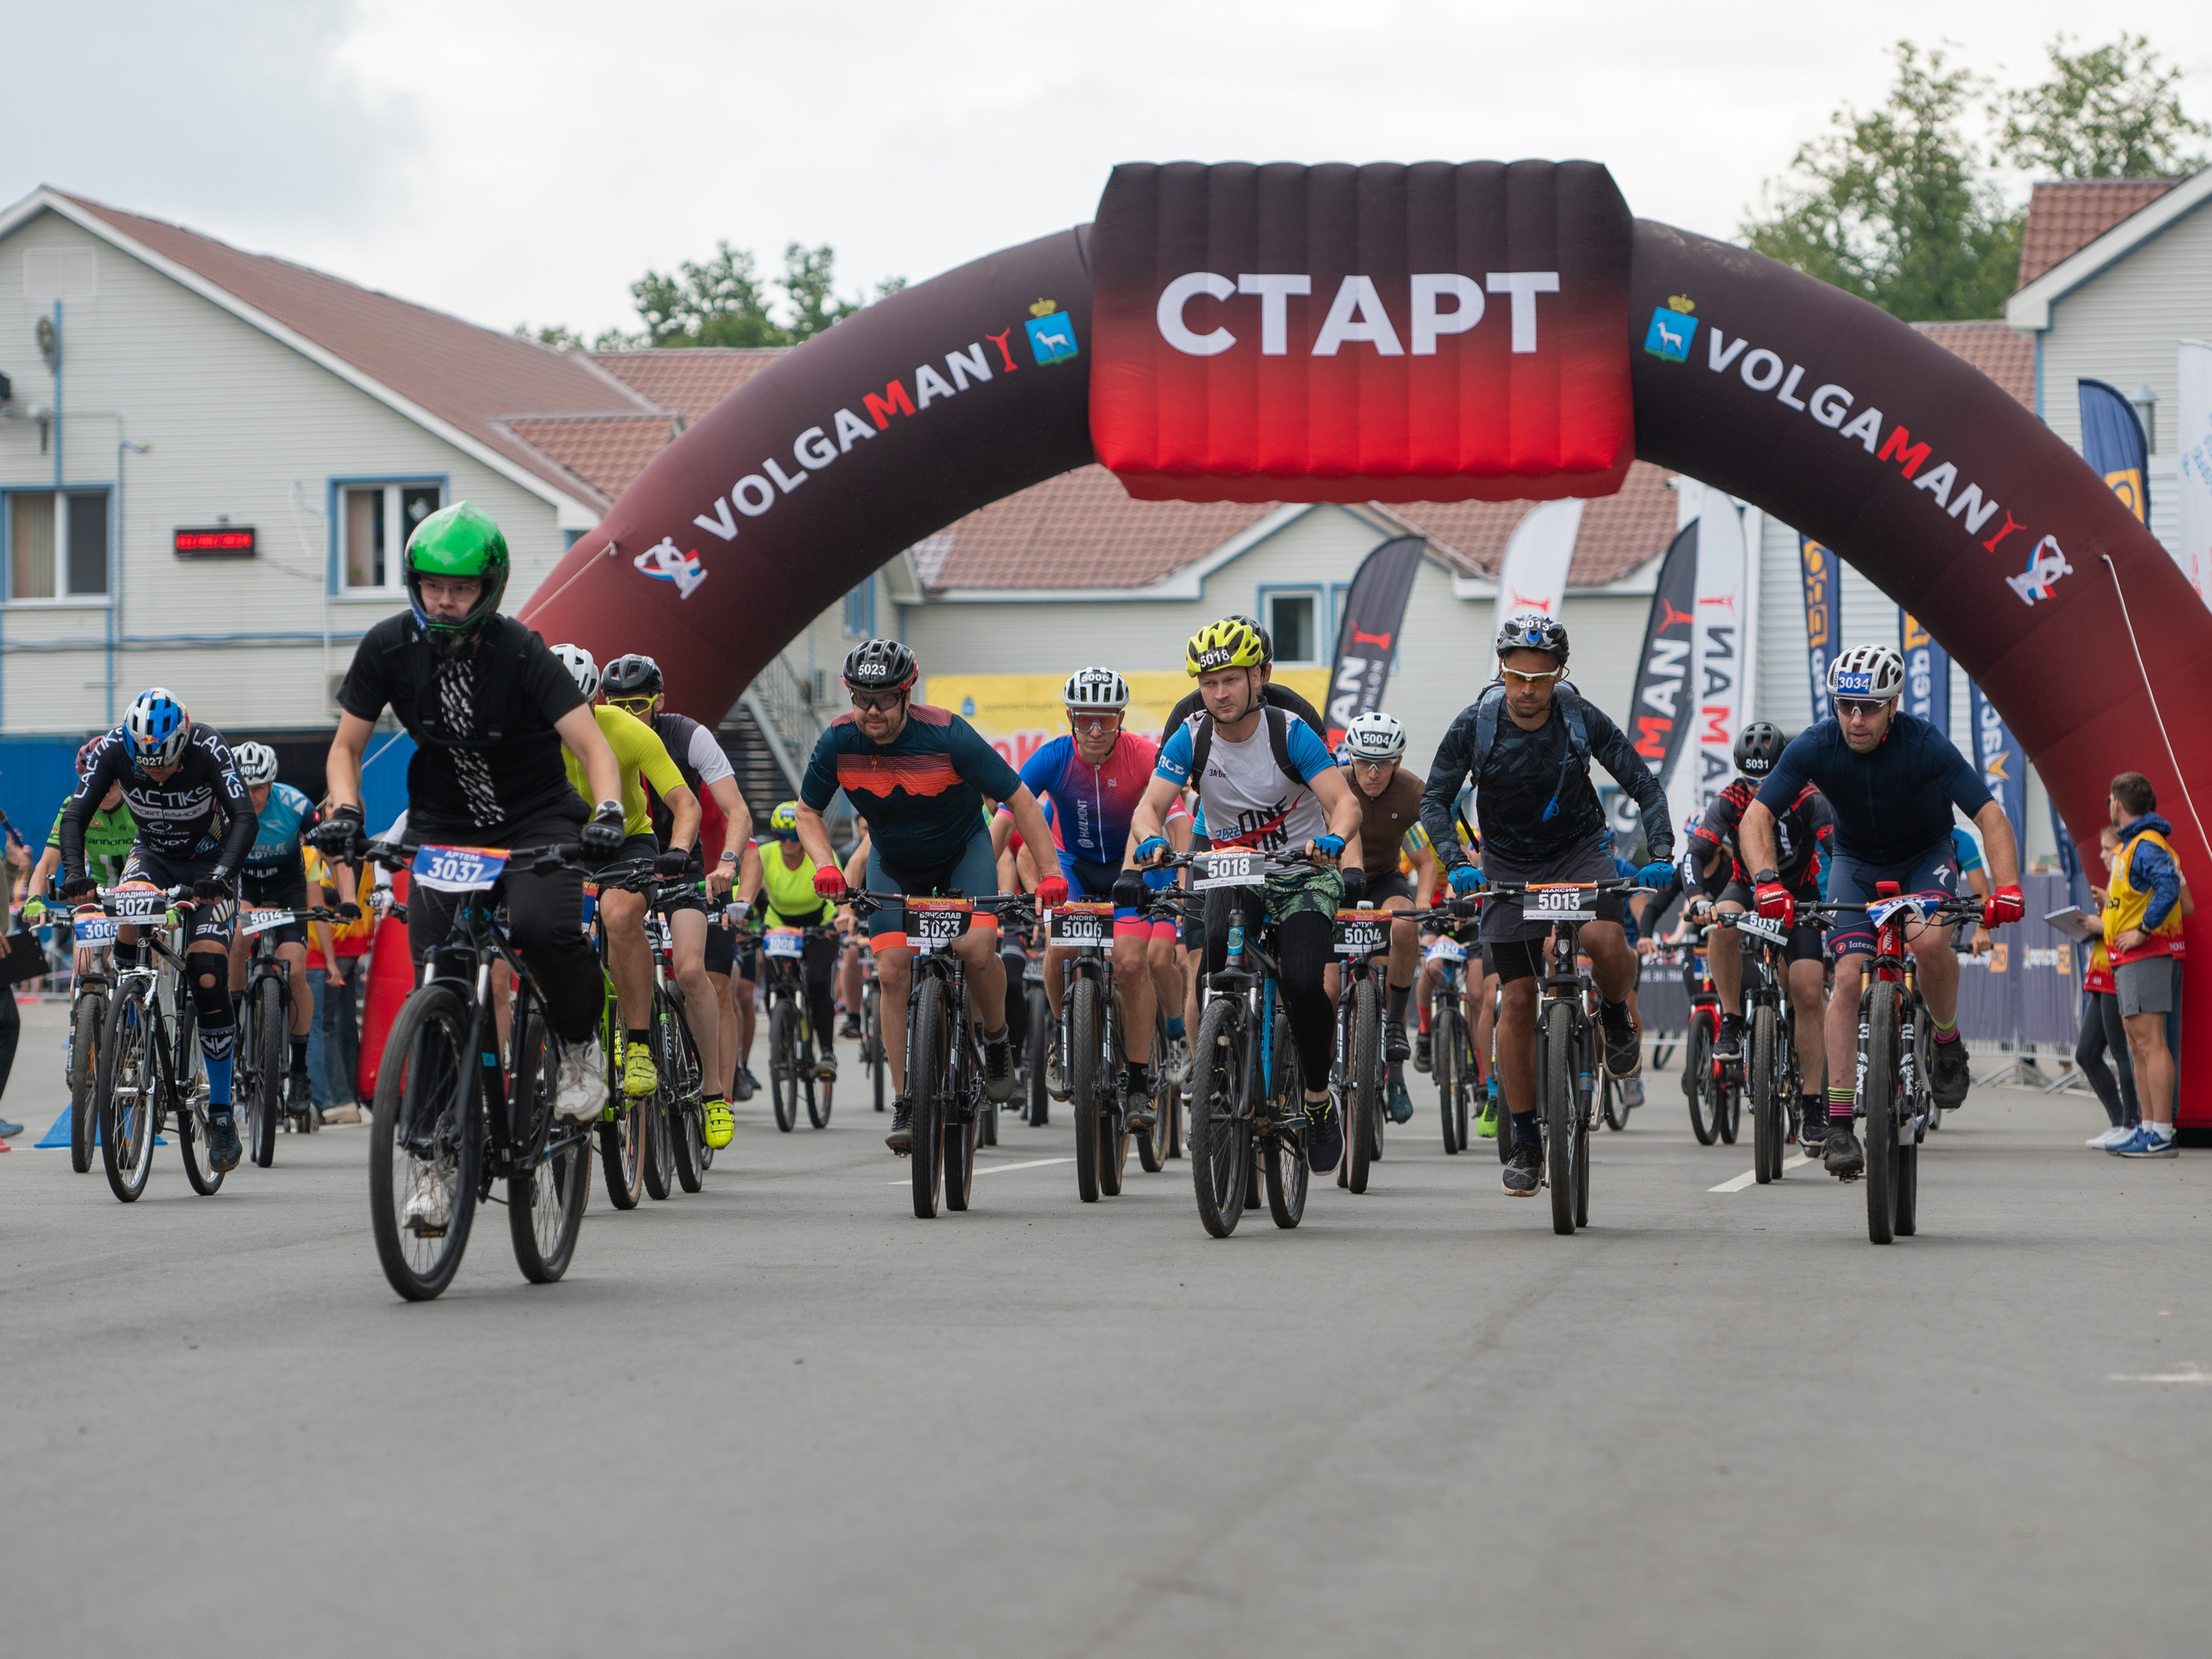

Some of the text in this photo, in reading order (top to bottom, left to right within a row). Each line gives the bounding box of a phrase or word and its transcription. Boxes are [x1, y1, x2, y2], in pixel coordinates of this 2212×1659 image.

[1156, 271, 1560, 357] СТАРТ
[1707, 326, 2000, 536] VOLGAMAN
[693, 342, 995, 542] VOLGAMAN
[1518, 620, 1550, 632] 5013
[1200, 649, 1230, 668] 5018
[858, 664, 887, 676] 5023
[1081, 673, 1109, 683] 5006
[1839, 677, 1870, 690] 3034
[1363, 734, 1389, 746] 5004
[136, 755, 163, 766] 5027
[192, 728, 244, 799] LACTIKS
[1745, 758, 1769, 769] 5031
[118, 785, 213, 808] ACTIKS
[164, 806, 202, 817] ESHOP
[444, 851, 480, 861] АРТЕМ
[1211, 851, 1251, 860] АЛЕКСЕЙ
[427, 857, 484, 882] 3037
[1208, 858, 1250, 879] 5018
[1683, 853, 1696, 886] FOX
[115, 899, 154, 917] 5027
[1538, 893, 1580, 911] 5013
[251, 912, 283, 925] 5014
[1749, 914, 1782, 934] 5031
[919, 919, 961, 938] 5023
[1062, 921, 1103, 938] 5006
[1344, 927, 1382, 944] 5004
